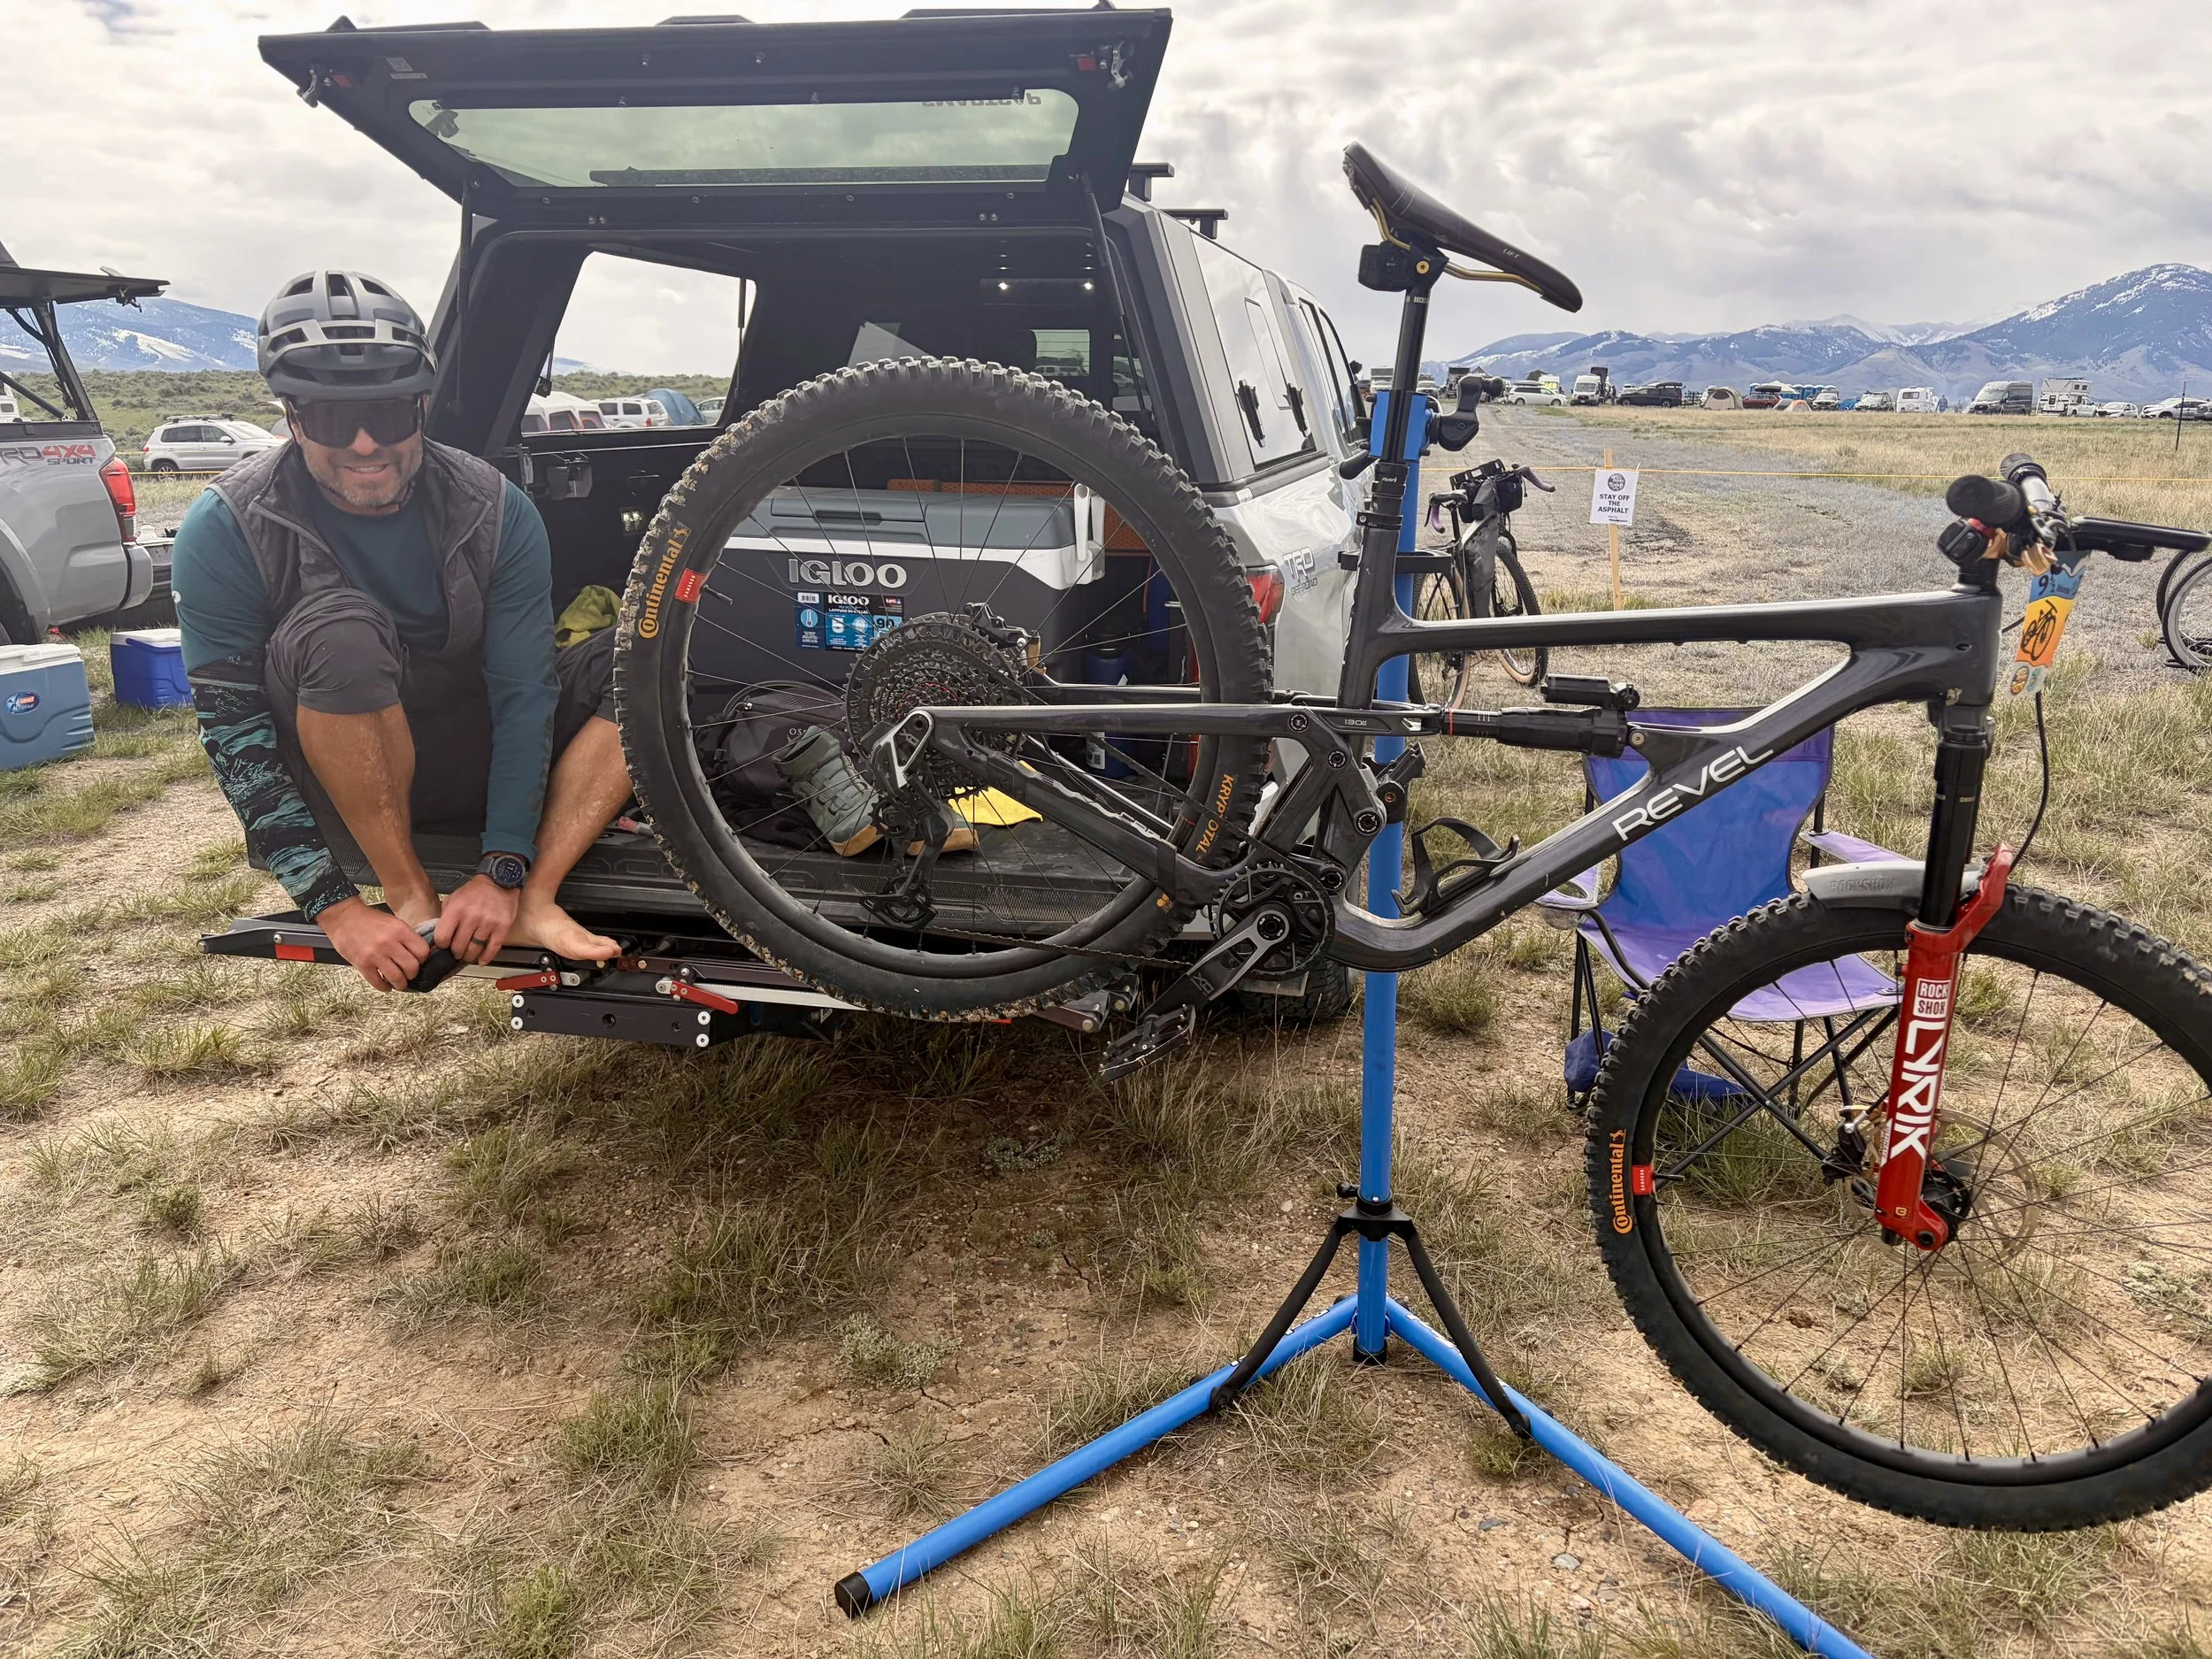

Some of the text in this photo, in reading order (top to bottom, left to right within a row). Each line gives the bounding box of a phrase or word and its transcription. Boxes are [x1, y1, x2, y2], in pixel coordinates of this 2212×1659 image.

[47, 457, 95, 465] SPORT
[788, 558, 908, 588] IGLOO
[1282, 547, 1315, 582] TRD
[638, 539, 683, 639] Continental
[827, 594, 870, 606] IGLOO
[2039, 575, 2049, 595] 9
[788, 727, 807, 736] OS
[1612, 746, 1774, 841] REVEL
[1195, 773, 1234, 854] KRYPOTAL
[1920, 982, 1947, 998] ROCK
[1917, 1000, 1947, 1015] SHOX
[1890, 1020, 1945, 1161] LYRIK
[1609, 1143, 1633, 1234] Continental
